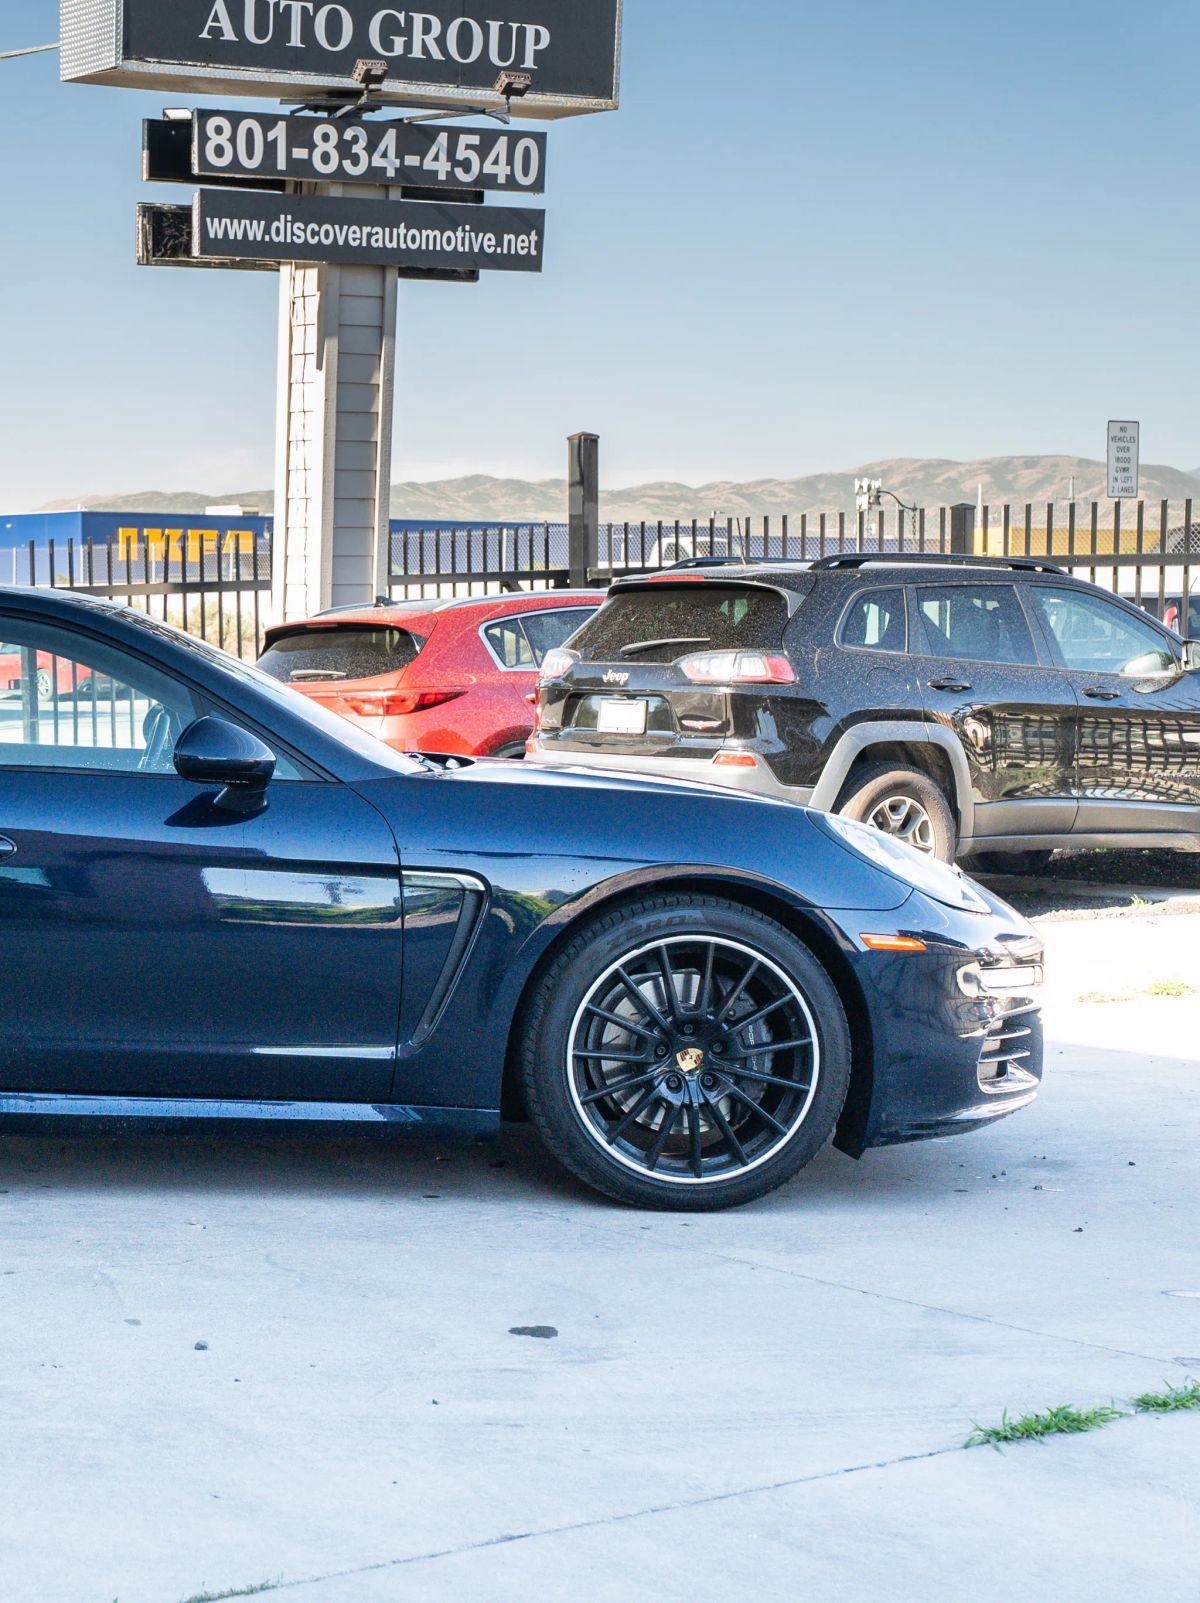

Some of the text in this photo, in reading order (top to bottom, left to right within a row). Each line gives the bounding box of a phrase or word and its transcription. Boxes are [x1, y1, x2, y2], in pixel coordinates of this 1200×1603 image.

[198, 0, 551, 69] AUTO GROUP
[204, 116, 540, 187] 801-834-4540
[205, 214, 538, 257] www.discoverautomotive.net
[602, 668, 630, 686] Jeep
